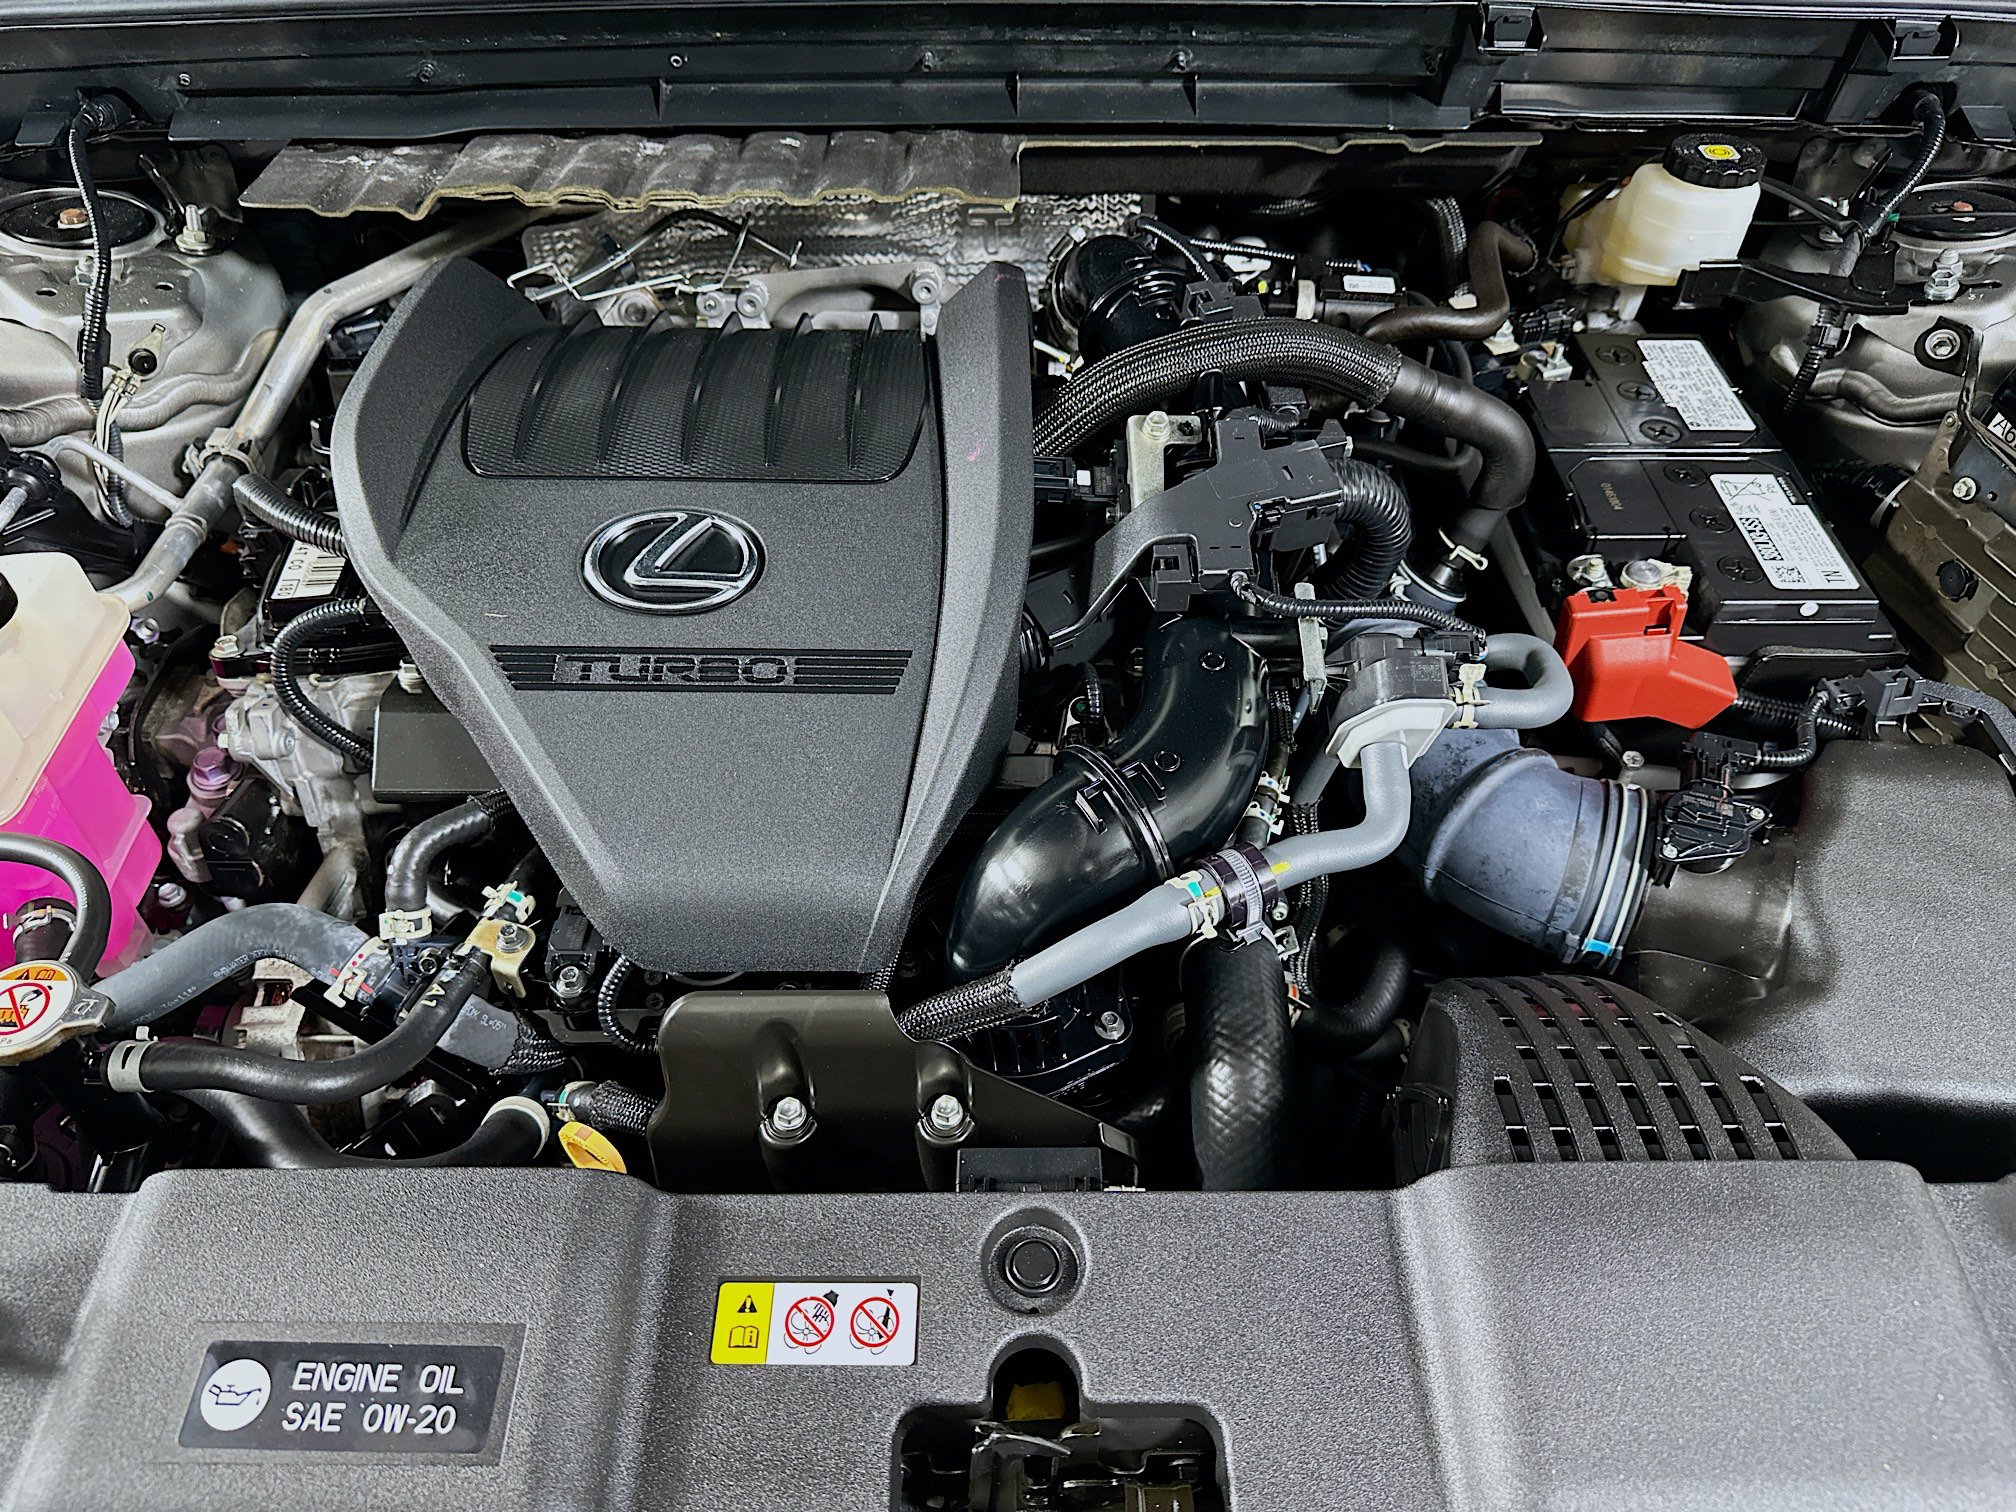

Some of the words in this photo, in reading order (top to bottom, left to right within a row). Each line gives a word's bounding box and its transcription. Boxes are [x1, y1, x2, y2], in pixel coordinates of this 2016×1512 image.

[277, 582, 294, 597] 180
[564, 655, 789, 684] TURBO
[292, 1361, 402, 1393] ENGINE
[419, 1364, 464, 1394] OIL
[282, 1401, 346, 1432] SAE
[362, 1403, 457, 1434] 0W-20
